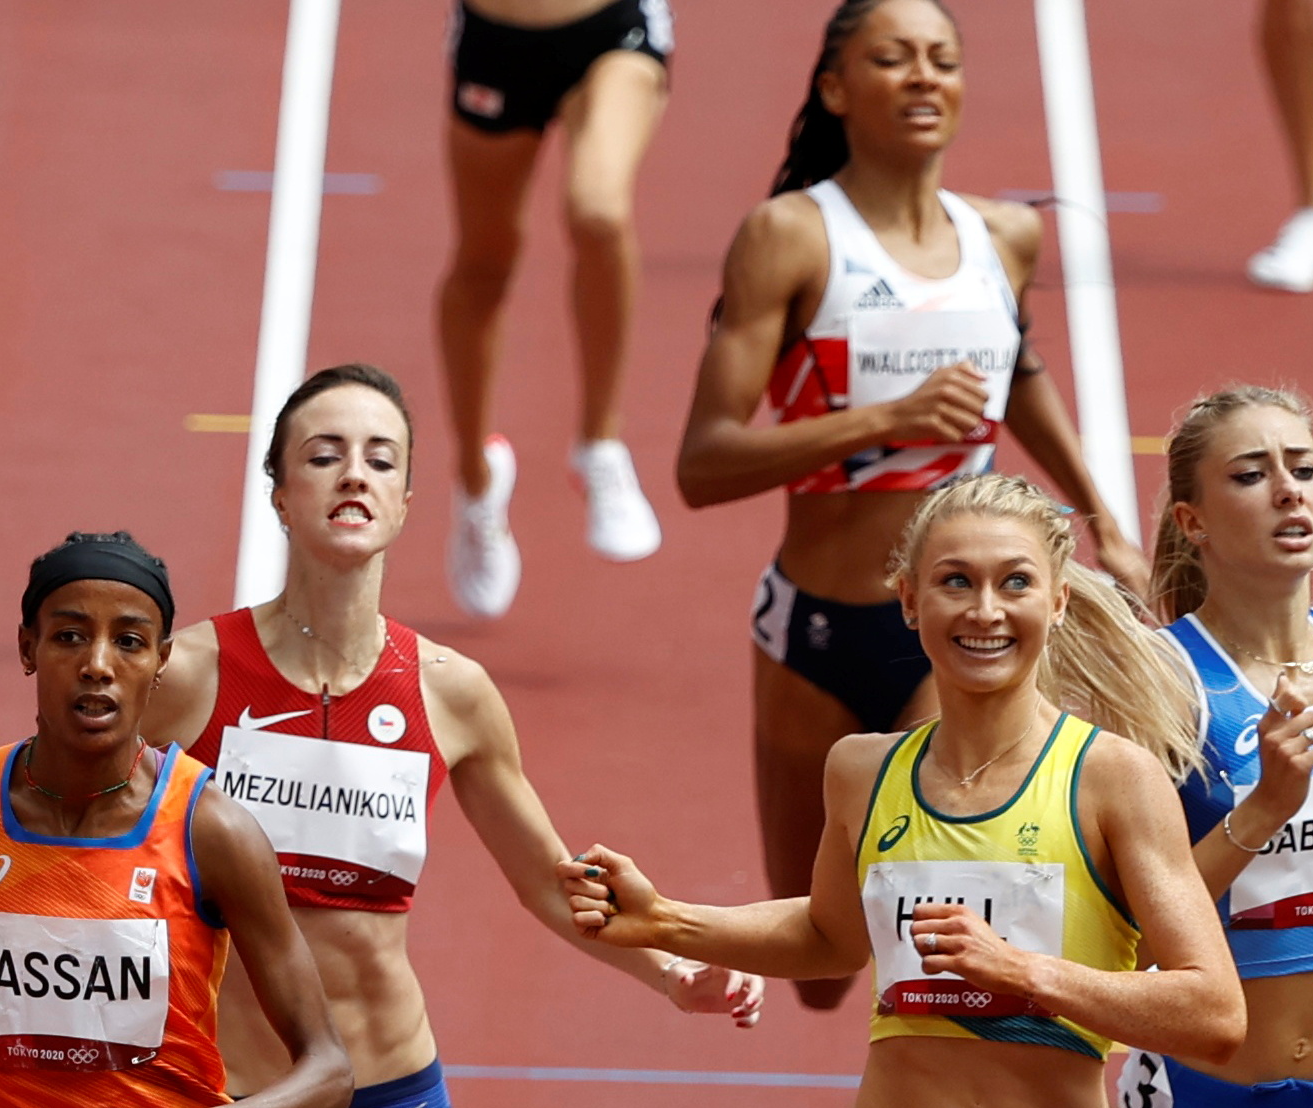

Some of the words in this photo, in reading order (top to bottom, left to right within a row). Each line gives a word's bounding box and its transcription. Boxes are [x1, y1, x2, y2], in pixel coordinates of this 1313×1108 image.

[223, 771, 417, 824] MEZULIANIKOVA
[902, 991, 934, 1004] TOKYO
[935, 992, 959, 1004] 2020
[7, 1046, 39, 1059] TOKYO
[40, 1050, 65, 1061] 2020
